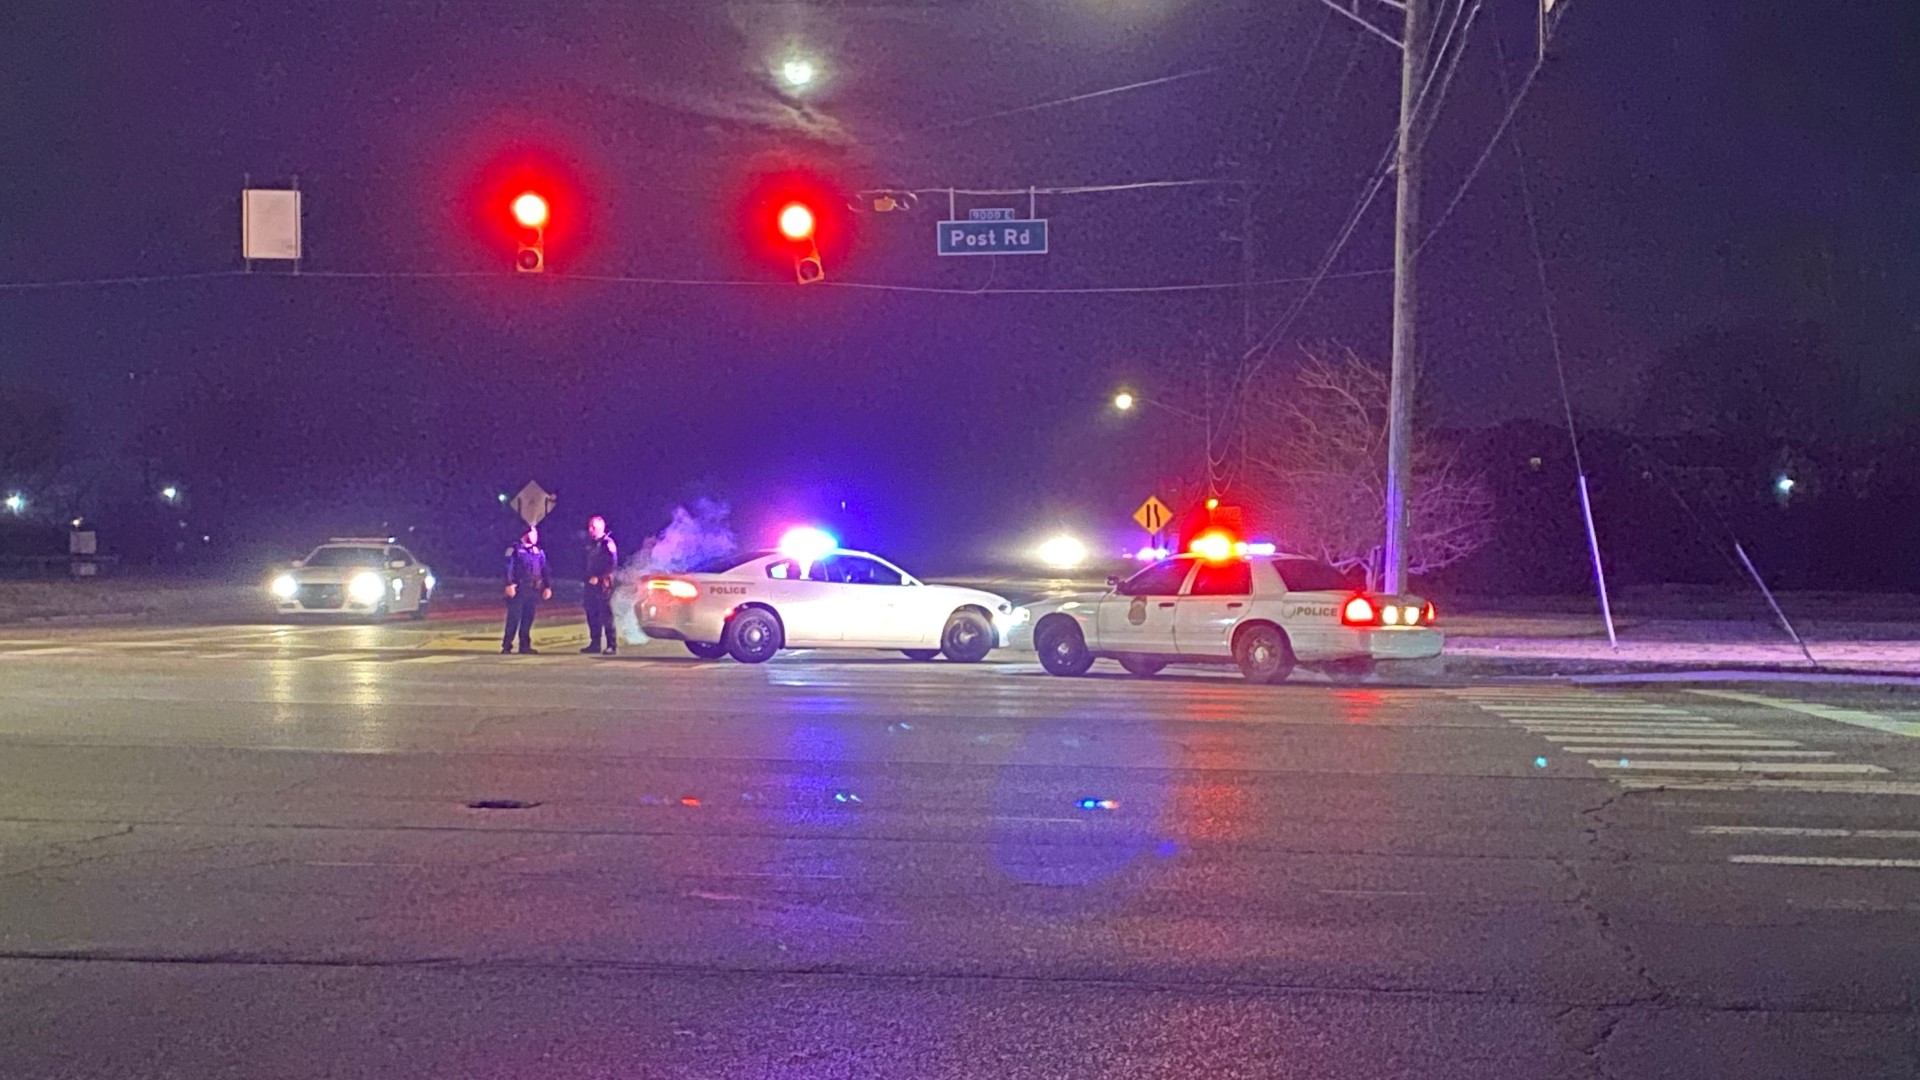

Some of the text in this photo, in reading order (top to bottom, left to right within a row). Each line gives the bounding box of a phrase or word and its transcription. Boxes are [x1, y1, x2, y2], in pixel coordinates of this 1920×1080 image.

[972, 211, 1001, 220] 9000
[951, 228, 1030, 246] Post Rd
[709, 586, 747, 595] POLICE
[1296, 606, 1338, 617] POLICE
